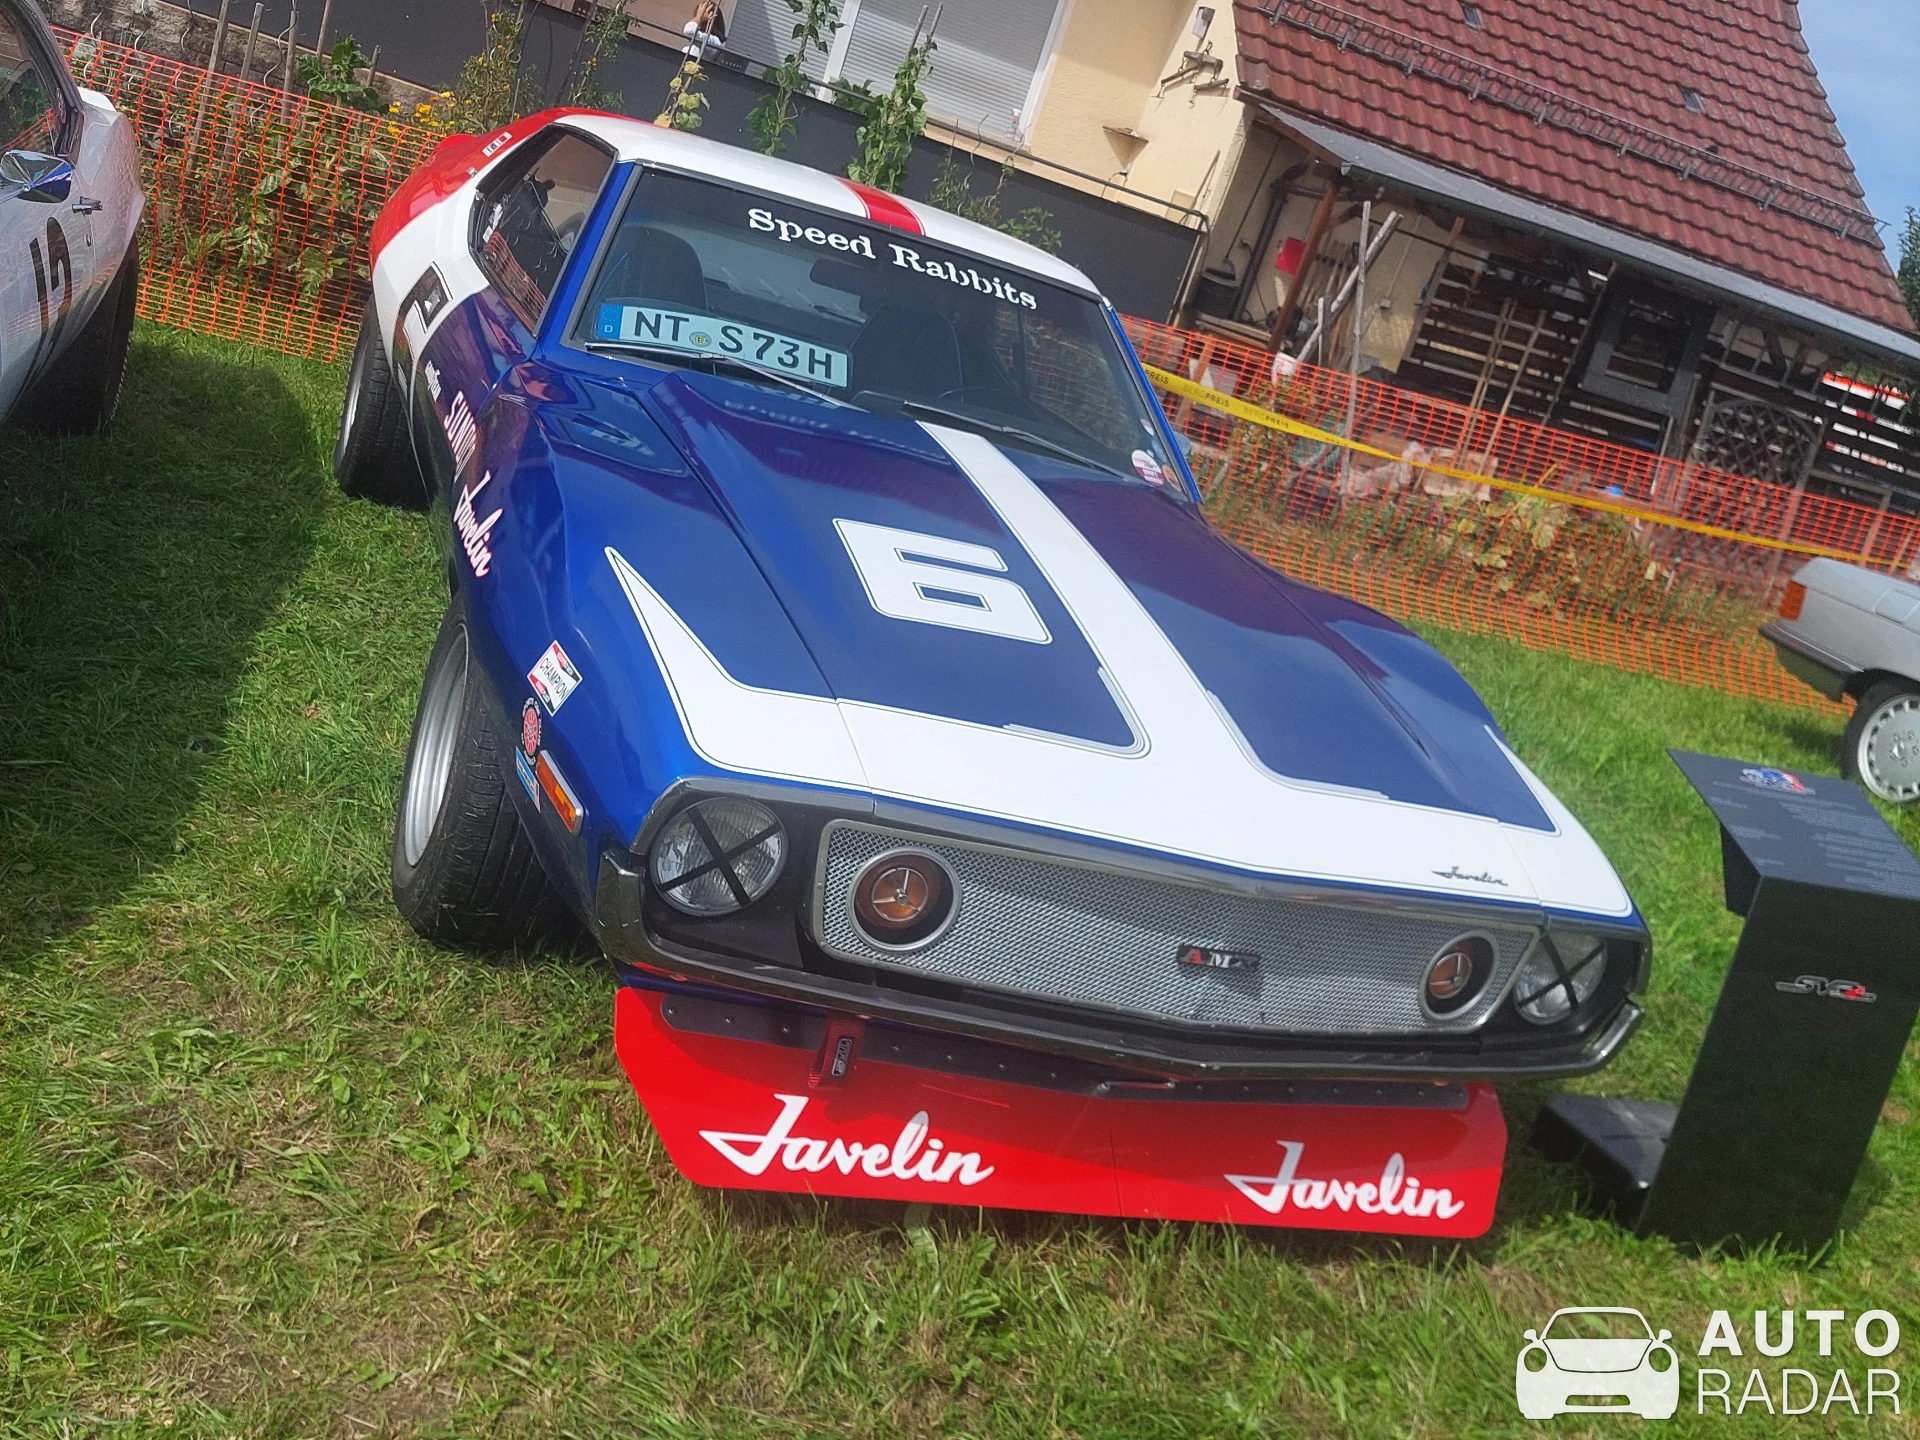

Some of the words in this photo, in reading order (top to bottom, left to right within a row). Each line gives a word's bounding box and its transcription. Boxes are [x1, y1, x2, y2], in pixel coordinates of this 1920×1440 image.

[748, 208, 877, 260] Speed
[888, 242, 1037, 310] Rabbits
[634, 311, 690, 343] NT
[453, 469, 503, 579] Javelin
[832, 517, 1053, 645] 6
[539, 657, 570, 700] CHAMPION
[1430, 865, 1509, 887] Javelin
[698, 1093, 996, 1186] Javelin
[1223, 1139, 1466, 1220] Javelin
